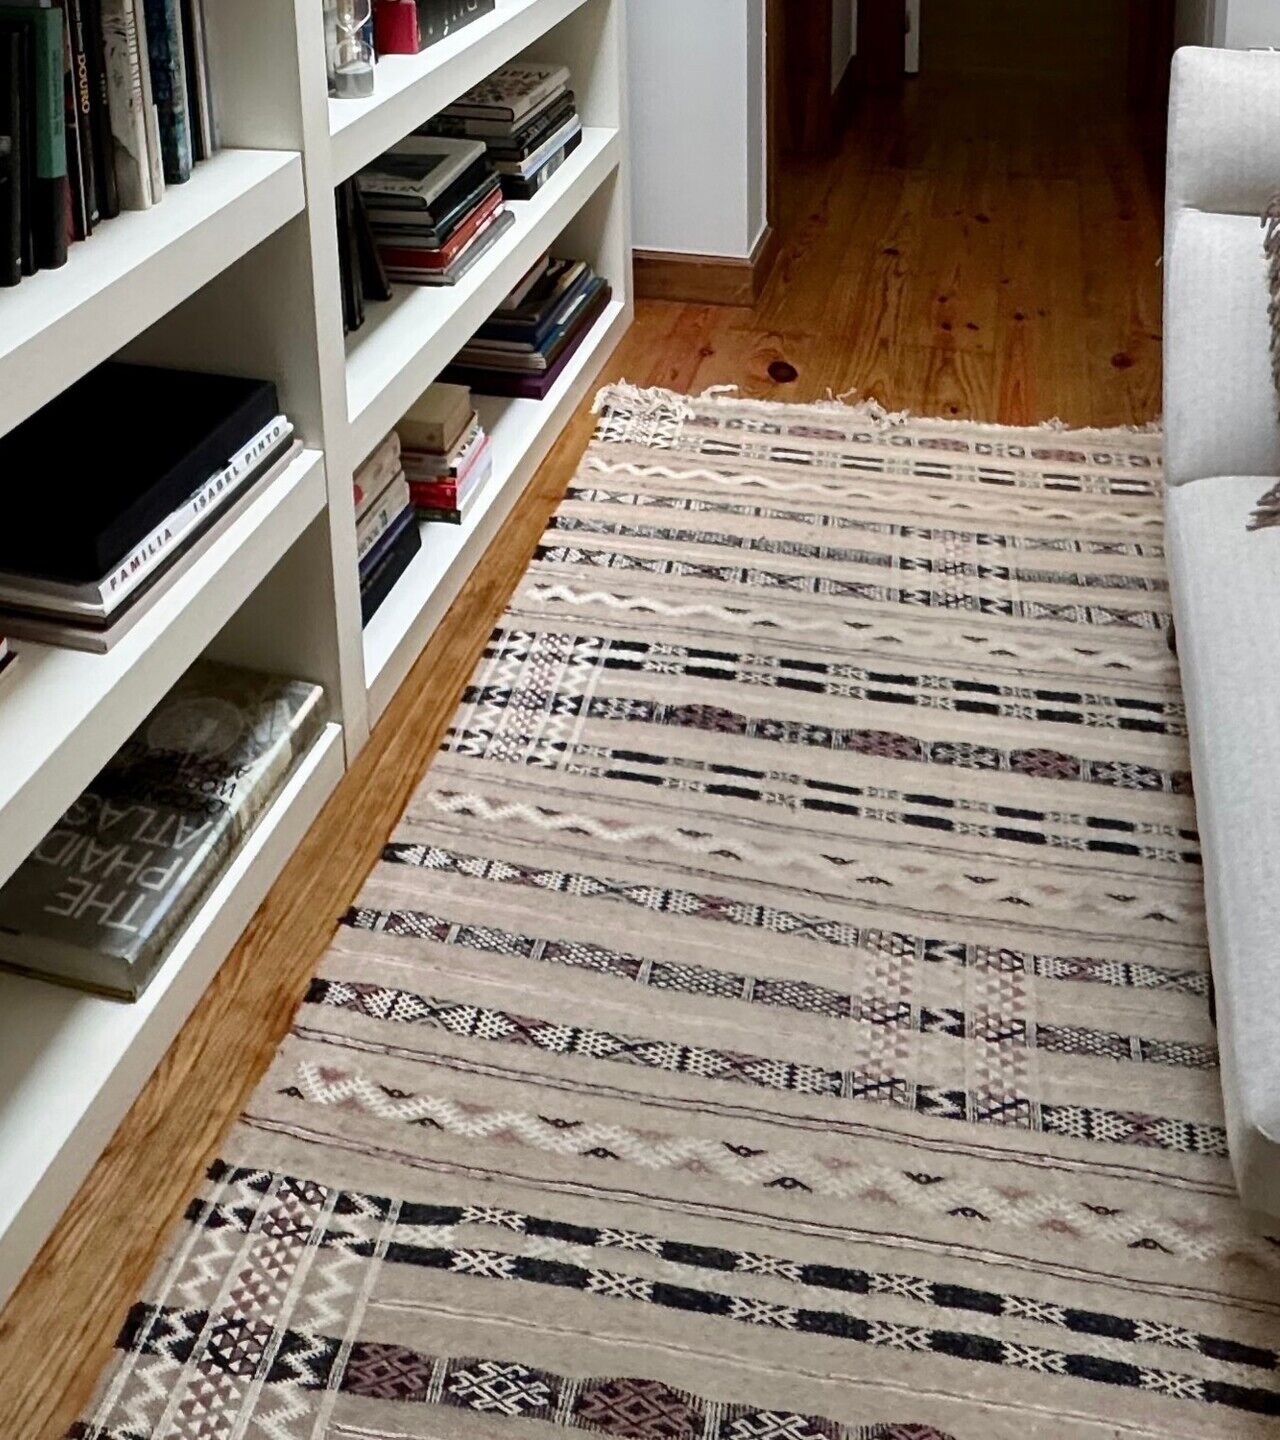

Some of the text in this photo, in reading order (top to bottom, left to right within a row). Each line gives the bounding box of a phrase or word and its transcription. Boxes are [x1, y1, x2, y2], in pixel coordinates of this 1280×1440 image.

[191, 457, 242, 515] ISABEL
[242, 424, 282, 466] PINTO
[64, 792, 213, 850] ATLAS
[44, 875, 147, 933] THE
